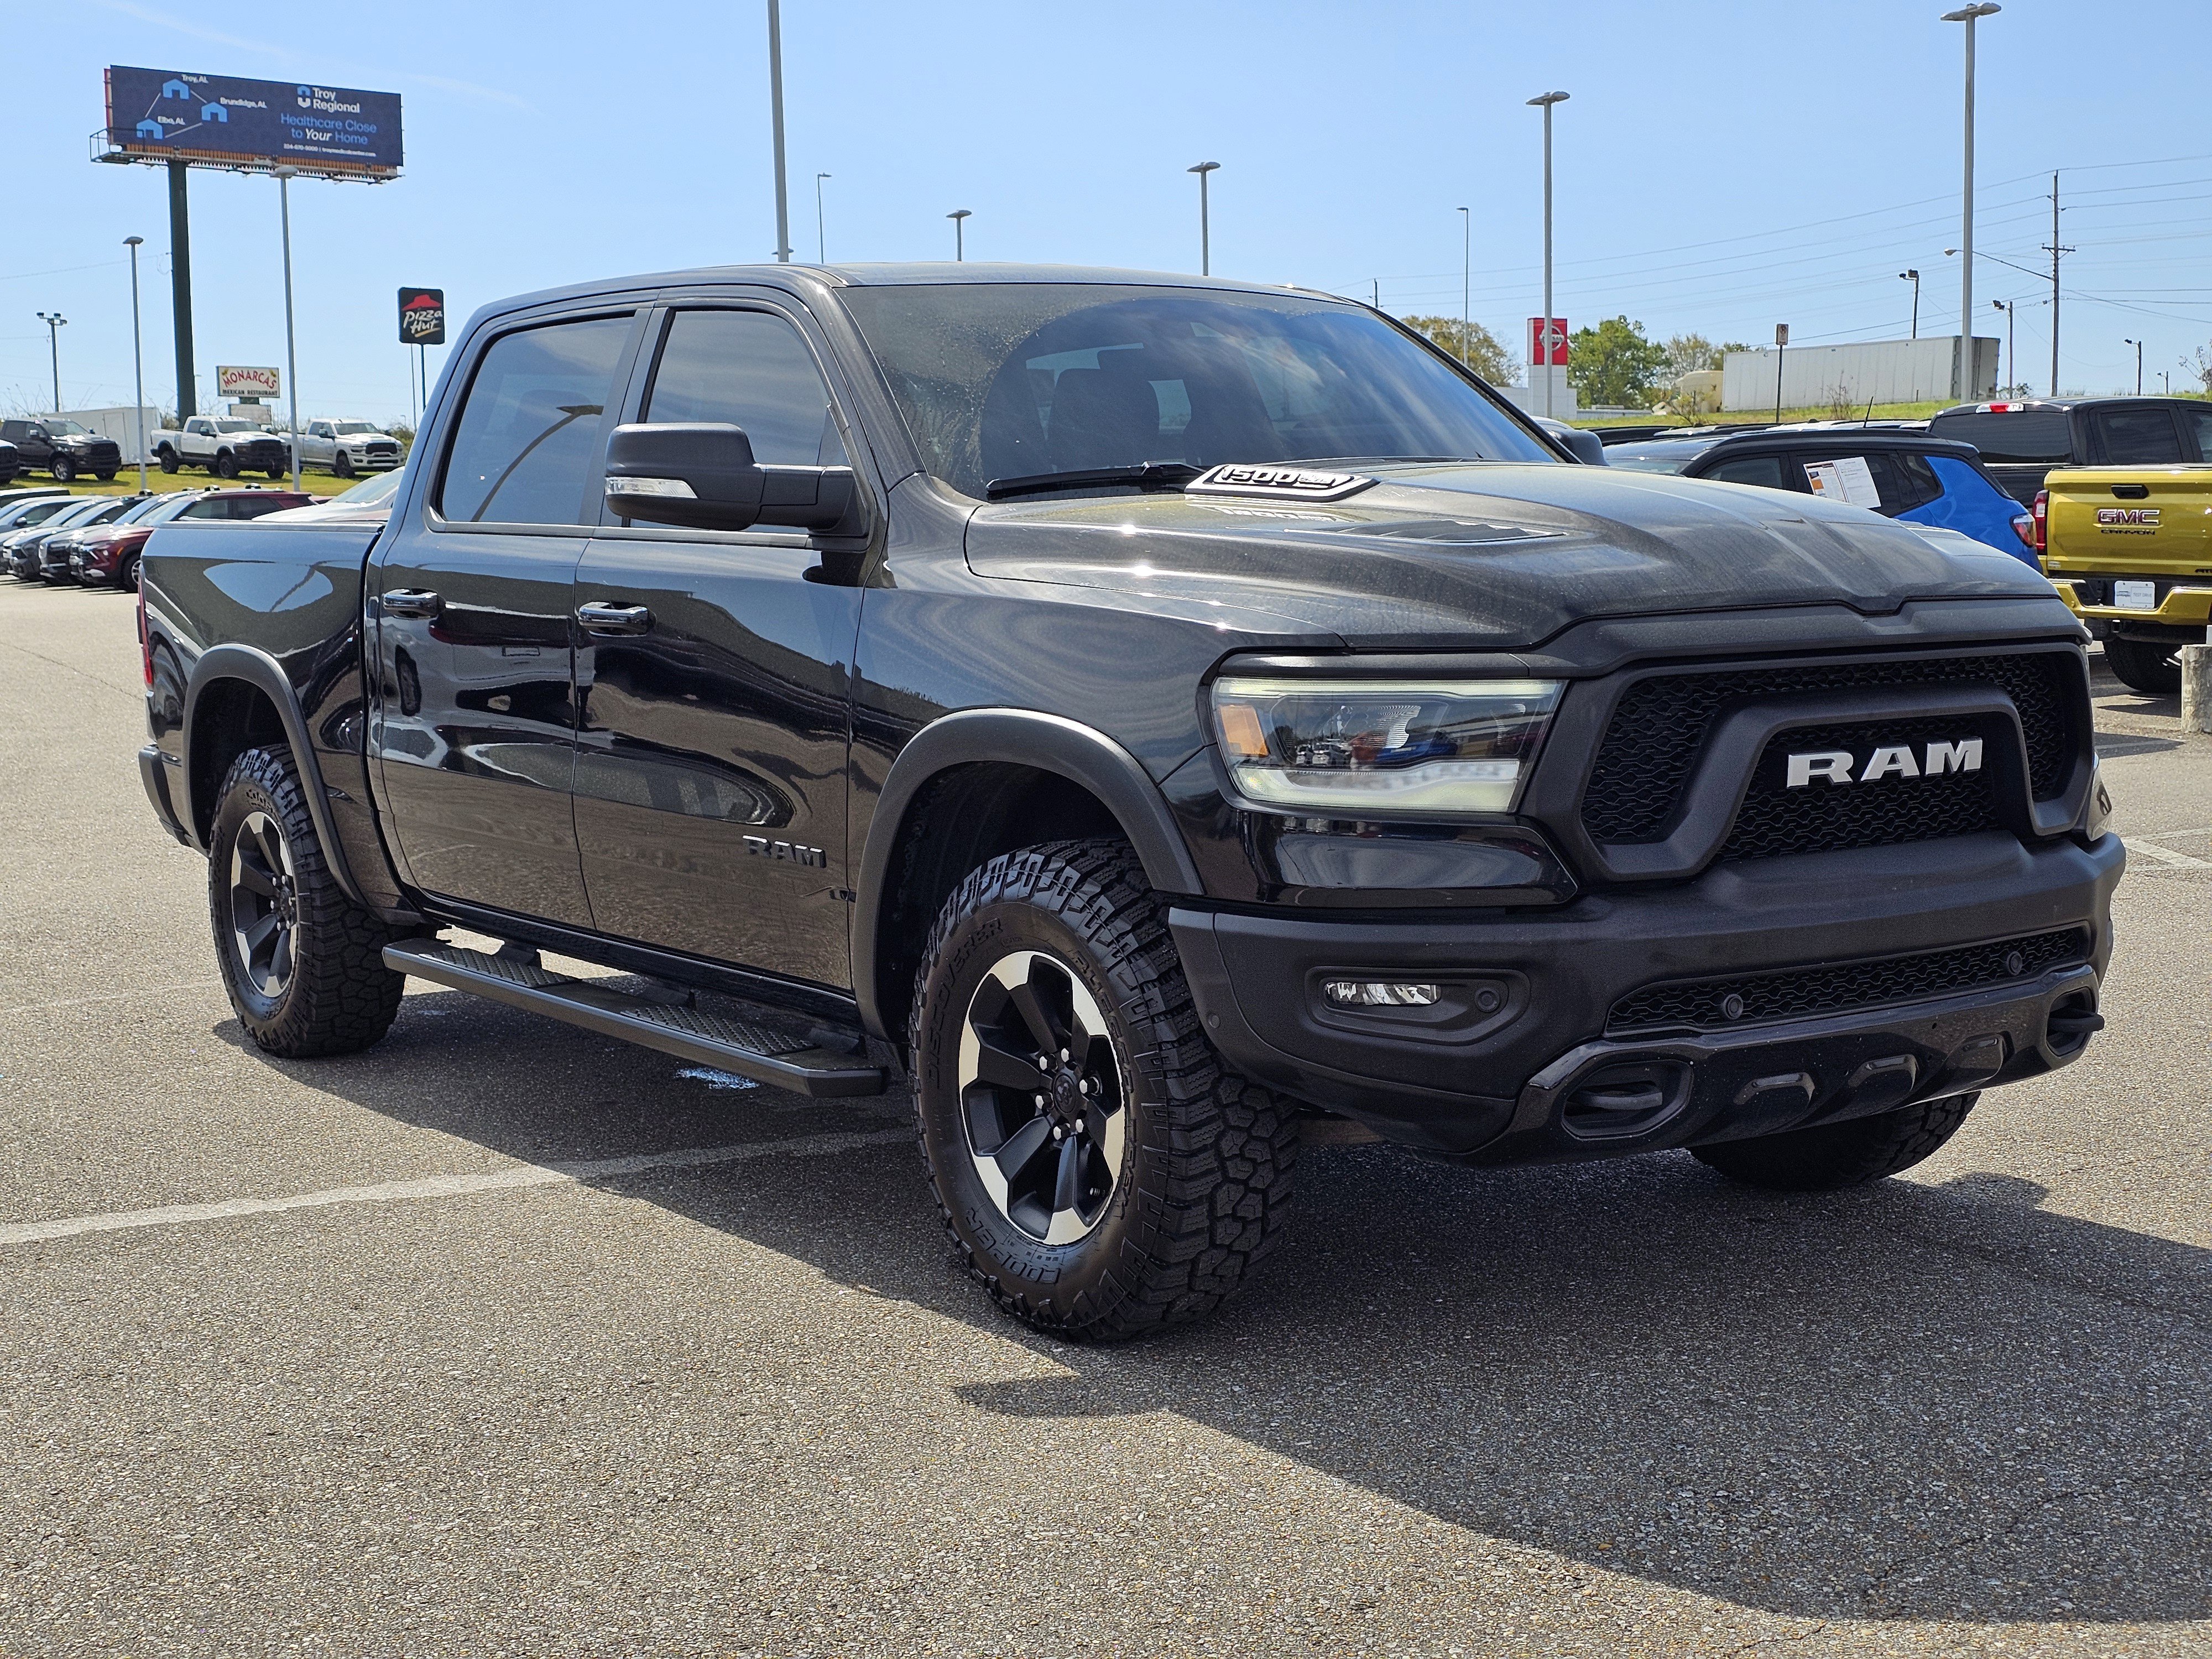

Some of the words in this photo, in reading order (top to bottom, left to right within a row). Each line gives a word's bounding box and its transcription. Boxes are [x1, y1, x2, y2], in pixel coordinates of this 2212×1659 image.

[312, 87, 336, 101] Troy
[313, 98, 360, 113] Regional
[281, 113, 342, 130] Healthcare
[345, 119, 377, 133] Close
[291, 127, 302, 138] to
[306, 128, 332, 141] Your
[335, 131, 368, 145] Home
[403, 308, 442, 328] Pizza
[410, 319, 439, 334] Hut
[222, 369, 276, 389] MONARCAS
[1222, 467, 1301, 483] 1500
[2097, 508, 2161, 525] GMC
[1787, 737, 1983, 788] RAM
[742, 835, 827, 869] RAM
[966, 1207, 1061, 1286] COOPER
